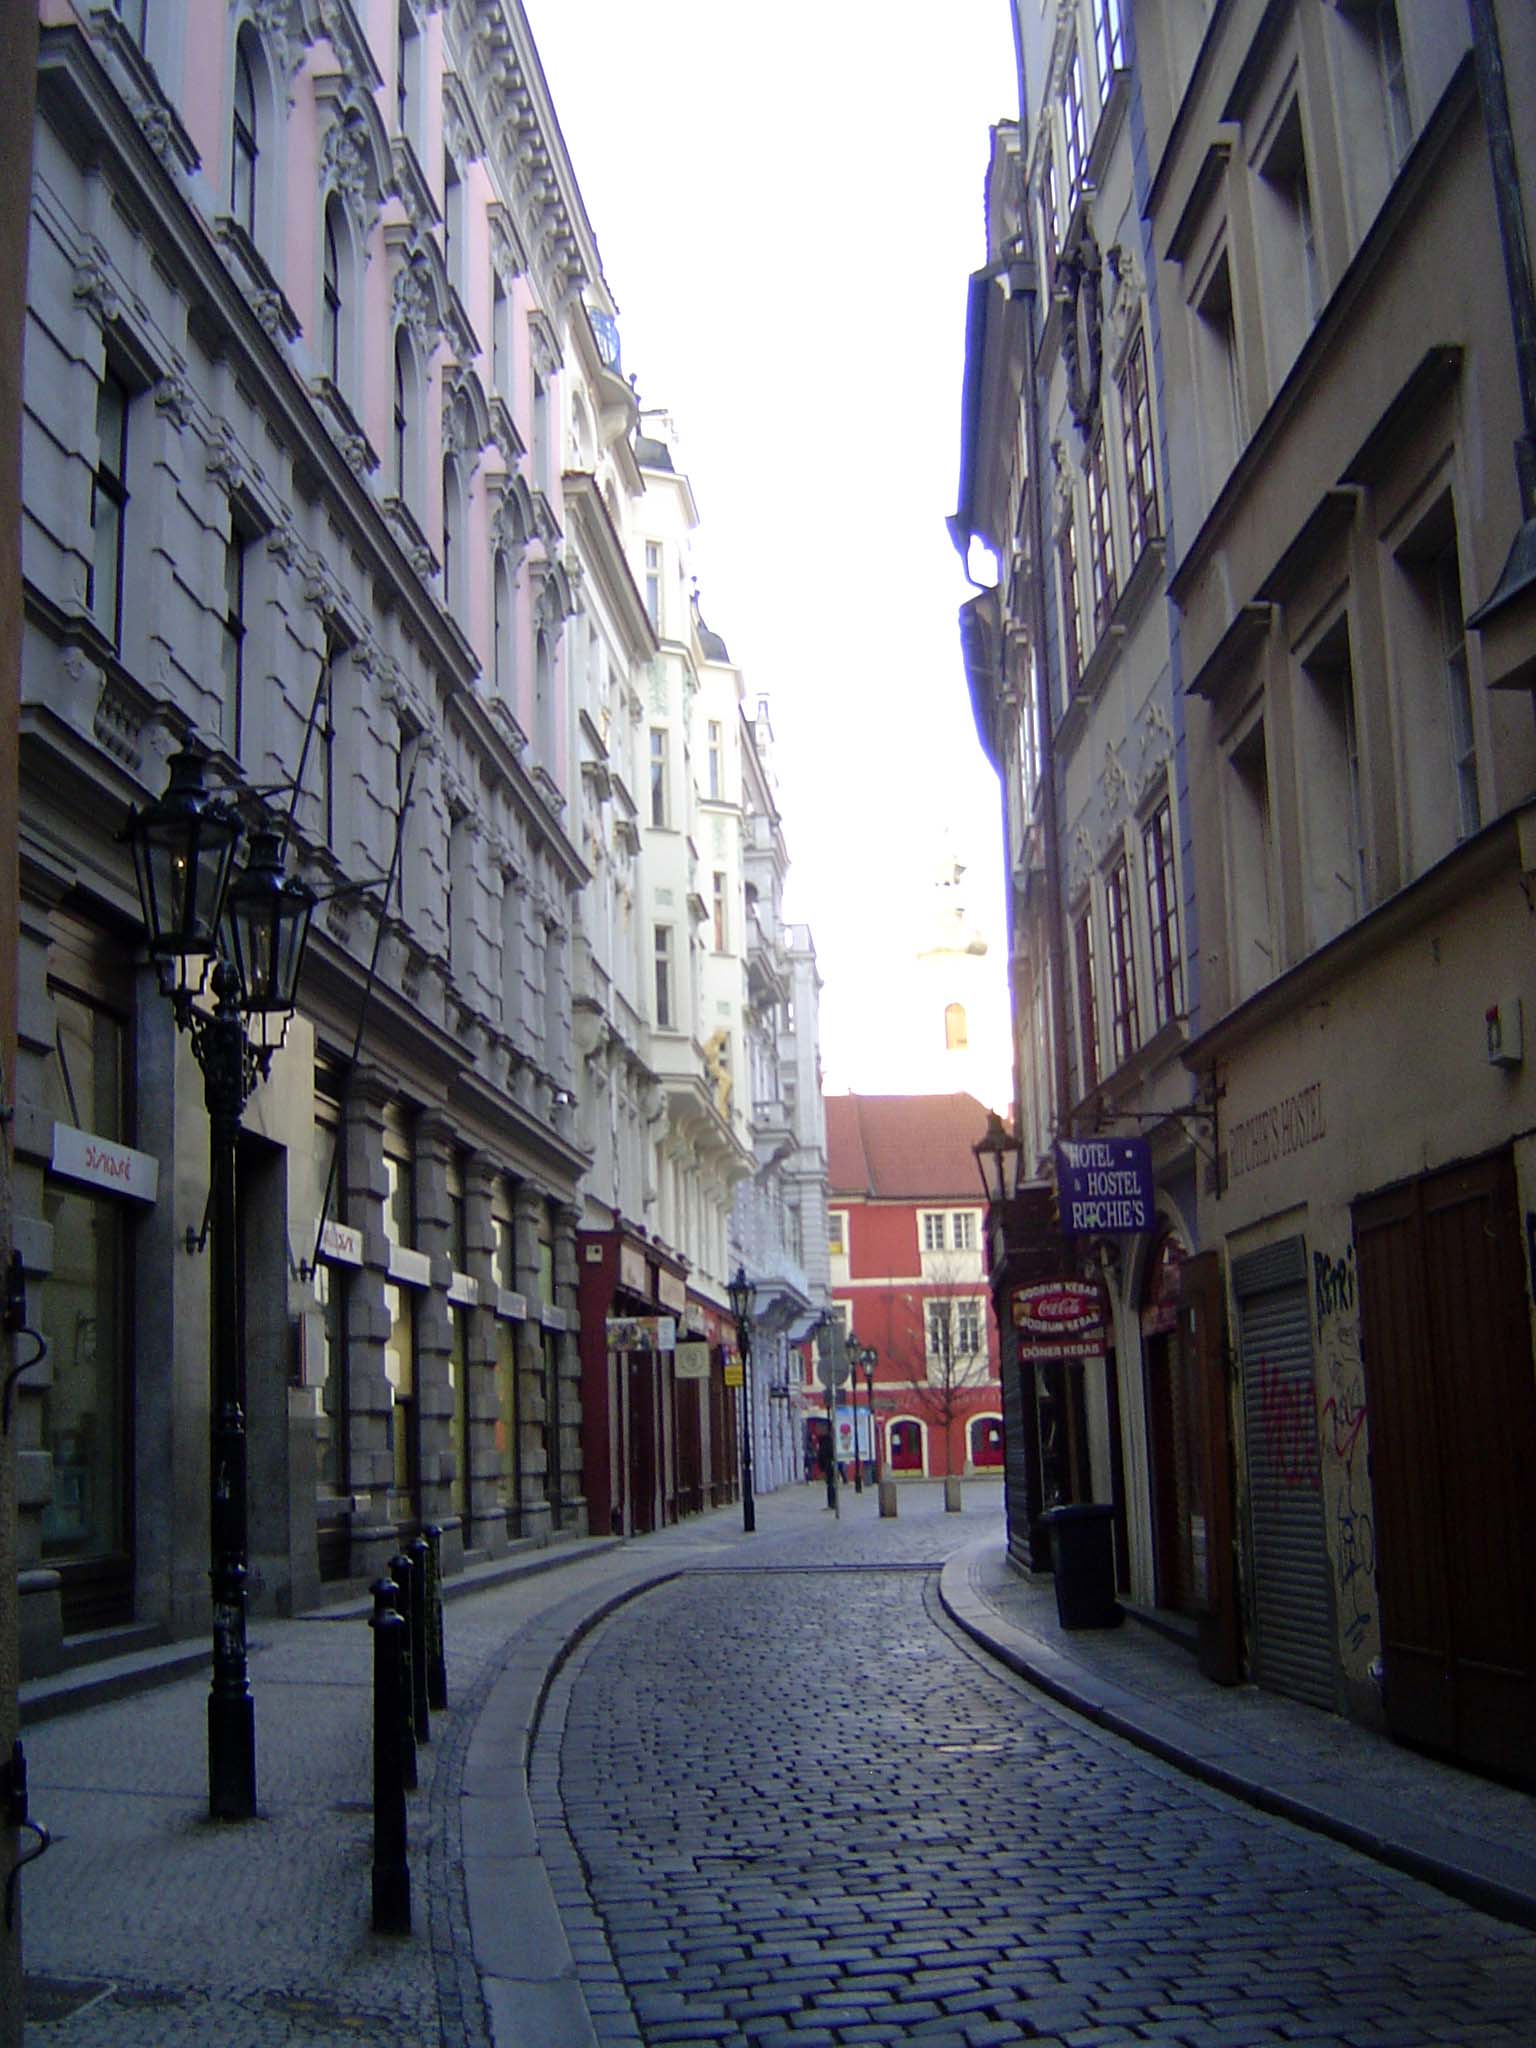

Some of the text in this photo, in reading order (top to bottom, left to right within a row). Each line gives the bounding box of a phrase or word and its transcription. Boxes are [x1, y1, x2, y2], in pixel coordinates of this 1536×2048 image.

[1280, 1081, 1326, 1156] HOSTEL
[1071, 1144, 1115, 1168] HOTEL
[1088, 1171, 1141, 1196] HOSTEL
[1072, 1200, 1145, 1229] RITCHIE'S
[1065, 1282, 1098, 1296] KEBAB
[1066, 1313, 1099, 1331] KEBAB
[1063, 1343, 1100, 1355] KEBAB
